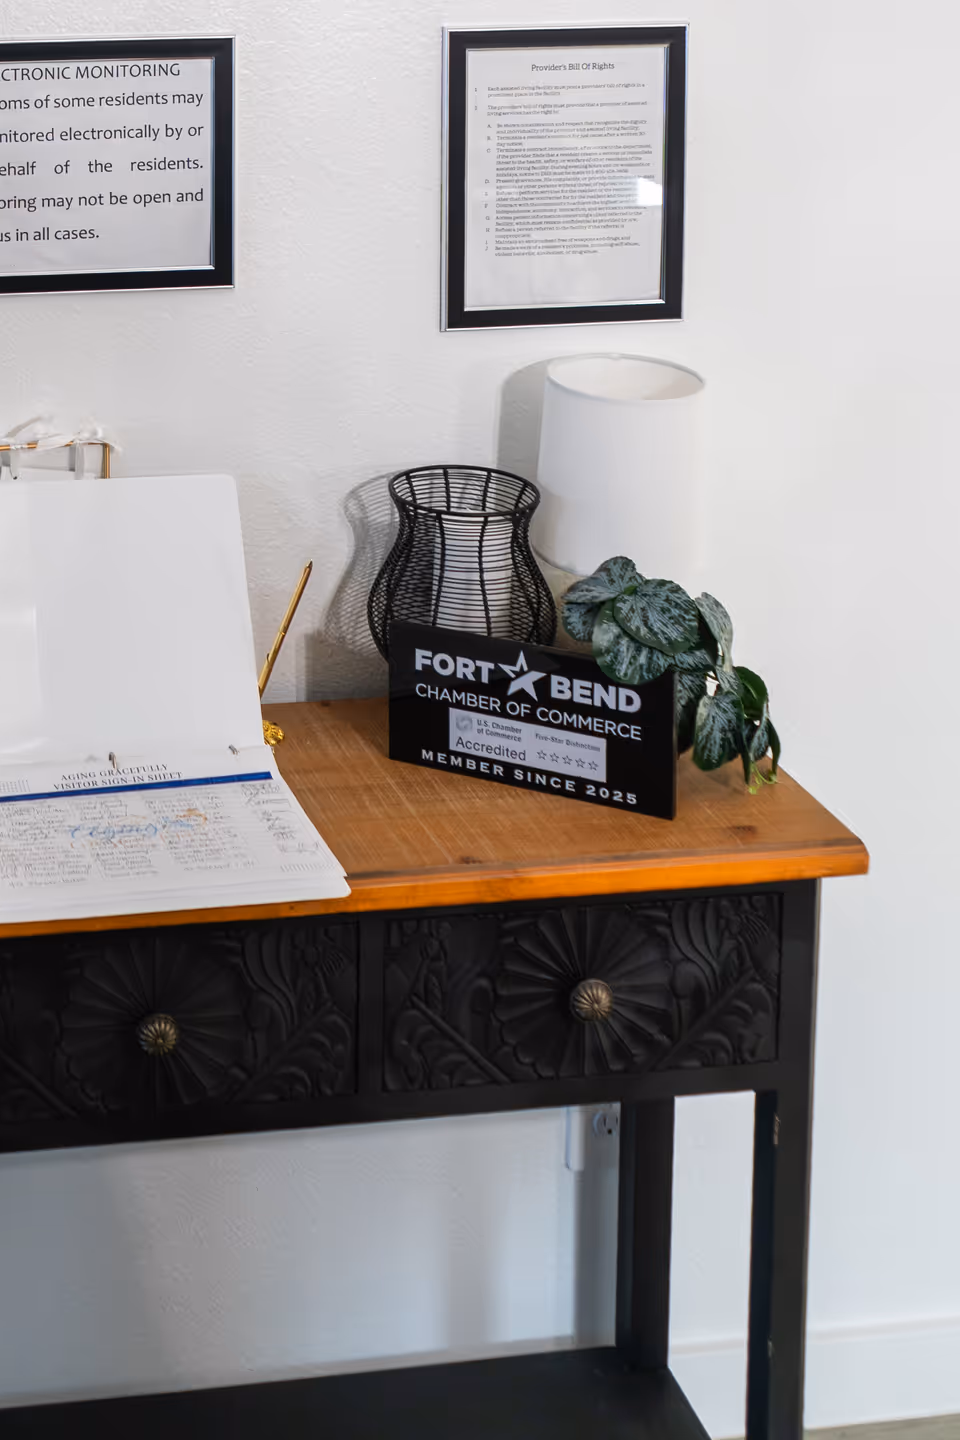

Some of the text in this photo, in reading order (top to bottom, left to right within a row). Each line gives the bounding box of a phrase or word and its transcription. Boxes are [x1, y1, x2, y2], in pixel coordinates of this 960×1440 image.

[75, 63, 180, 79] MONITORING
[531, 62, 615, 72] Provider's Bill Of Rights
[33, 94, 51, 109] of
[53, 96, 95, 109] some
[98, 92, 168, 107] residents
[171, 93, 204, 107] may
[59, 124, 160, 142] electronically
[165, 123, 183, 141] by
[187, 125, 204, 137] or
[53, 159, 70, 175] of
[87, 158, 113, 173] the
[130, 156, 204, 172] residents.
[414, 648, 641, 713] FORT BEND
[415, 682, 642, 741] CHAMBER OF COMMERCE
[453, 735, 526, 761] Accredited
[53, 771, 181, 791] VISITOR SIGN-IN SHEET
[61, 763, 167, 781] AGING GRACEFULLY
[421, 748, 637, 805] MEMBER SINCE 2025
